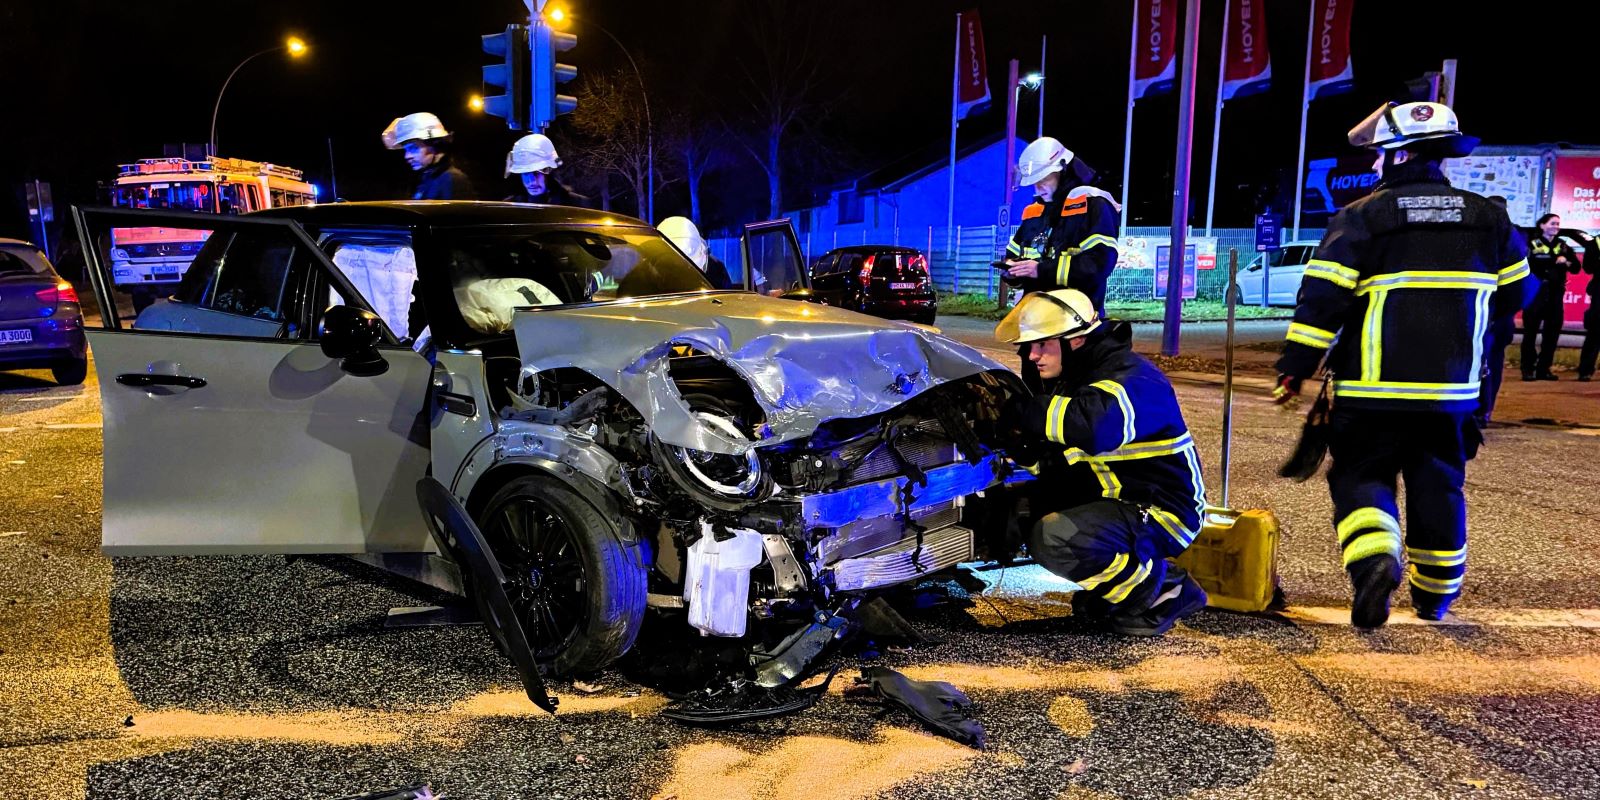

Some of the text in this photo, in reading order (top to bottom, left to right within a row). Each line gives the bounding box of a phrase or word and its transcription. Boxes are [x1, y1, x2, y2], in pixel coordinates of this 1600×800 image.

[1151, 0, 1161, 62] HOYE
[1241, 0, 1253, 63] HOYE
[968, 22, 980, 86] HOYER
[1573, 187, 1595, 198] Das
[1563, 291, 1582, 304] ür
[0, 331, 7, 341] A
